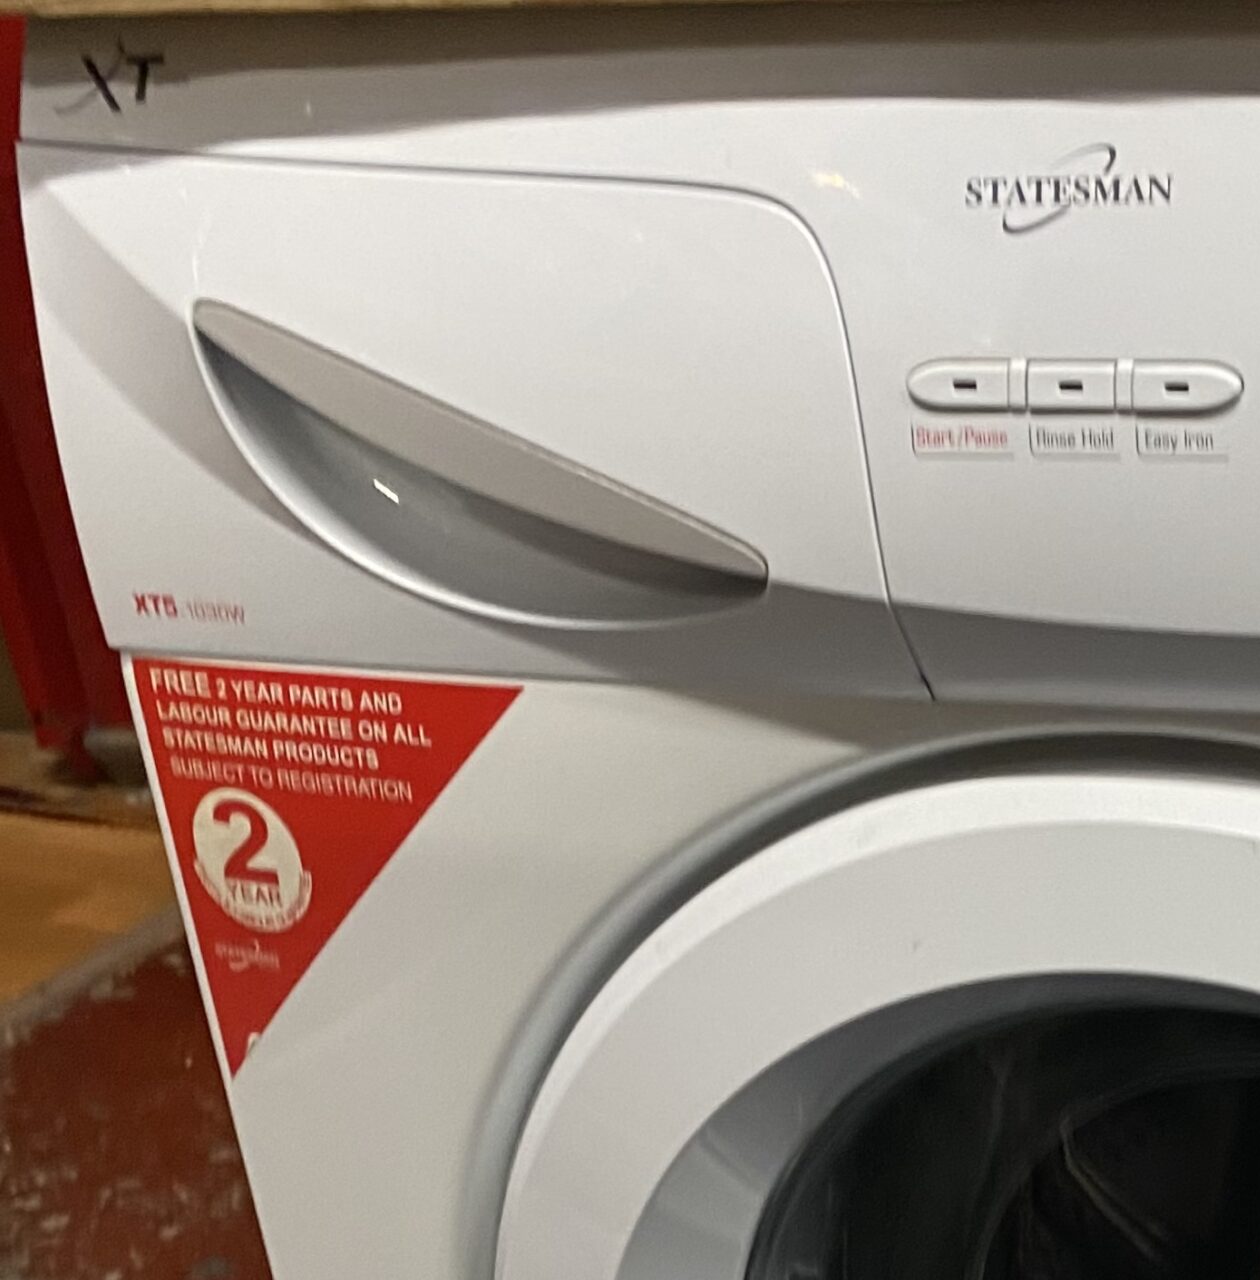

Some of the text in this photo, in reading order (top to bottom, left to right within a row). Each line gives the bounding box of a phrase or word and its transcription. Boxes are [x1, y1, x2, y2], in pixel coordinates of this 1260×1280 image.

[965, 173, 1174, 208] STATESMAN
[916, 424, 1008, 449] Start/Pause
[1035, 424, 1114, 449] Rinse Hold
[1145, 427, 1214, 455] Easy Iron
[149, 667, 402, 716] FREE 2 YEAR PARTS AND
[156, 699, 432, 748] LABOUR GUARANTEE ON ALL
[162, 729, 379, 770] STATESMAN PRODUCTS
[171, 755, 413, 804] SUBJECT TO REGISTRATION
[212, 799, 280, 885] 2
[229, 882, 283, 907] YEAR
